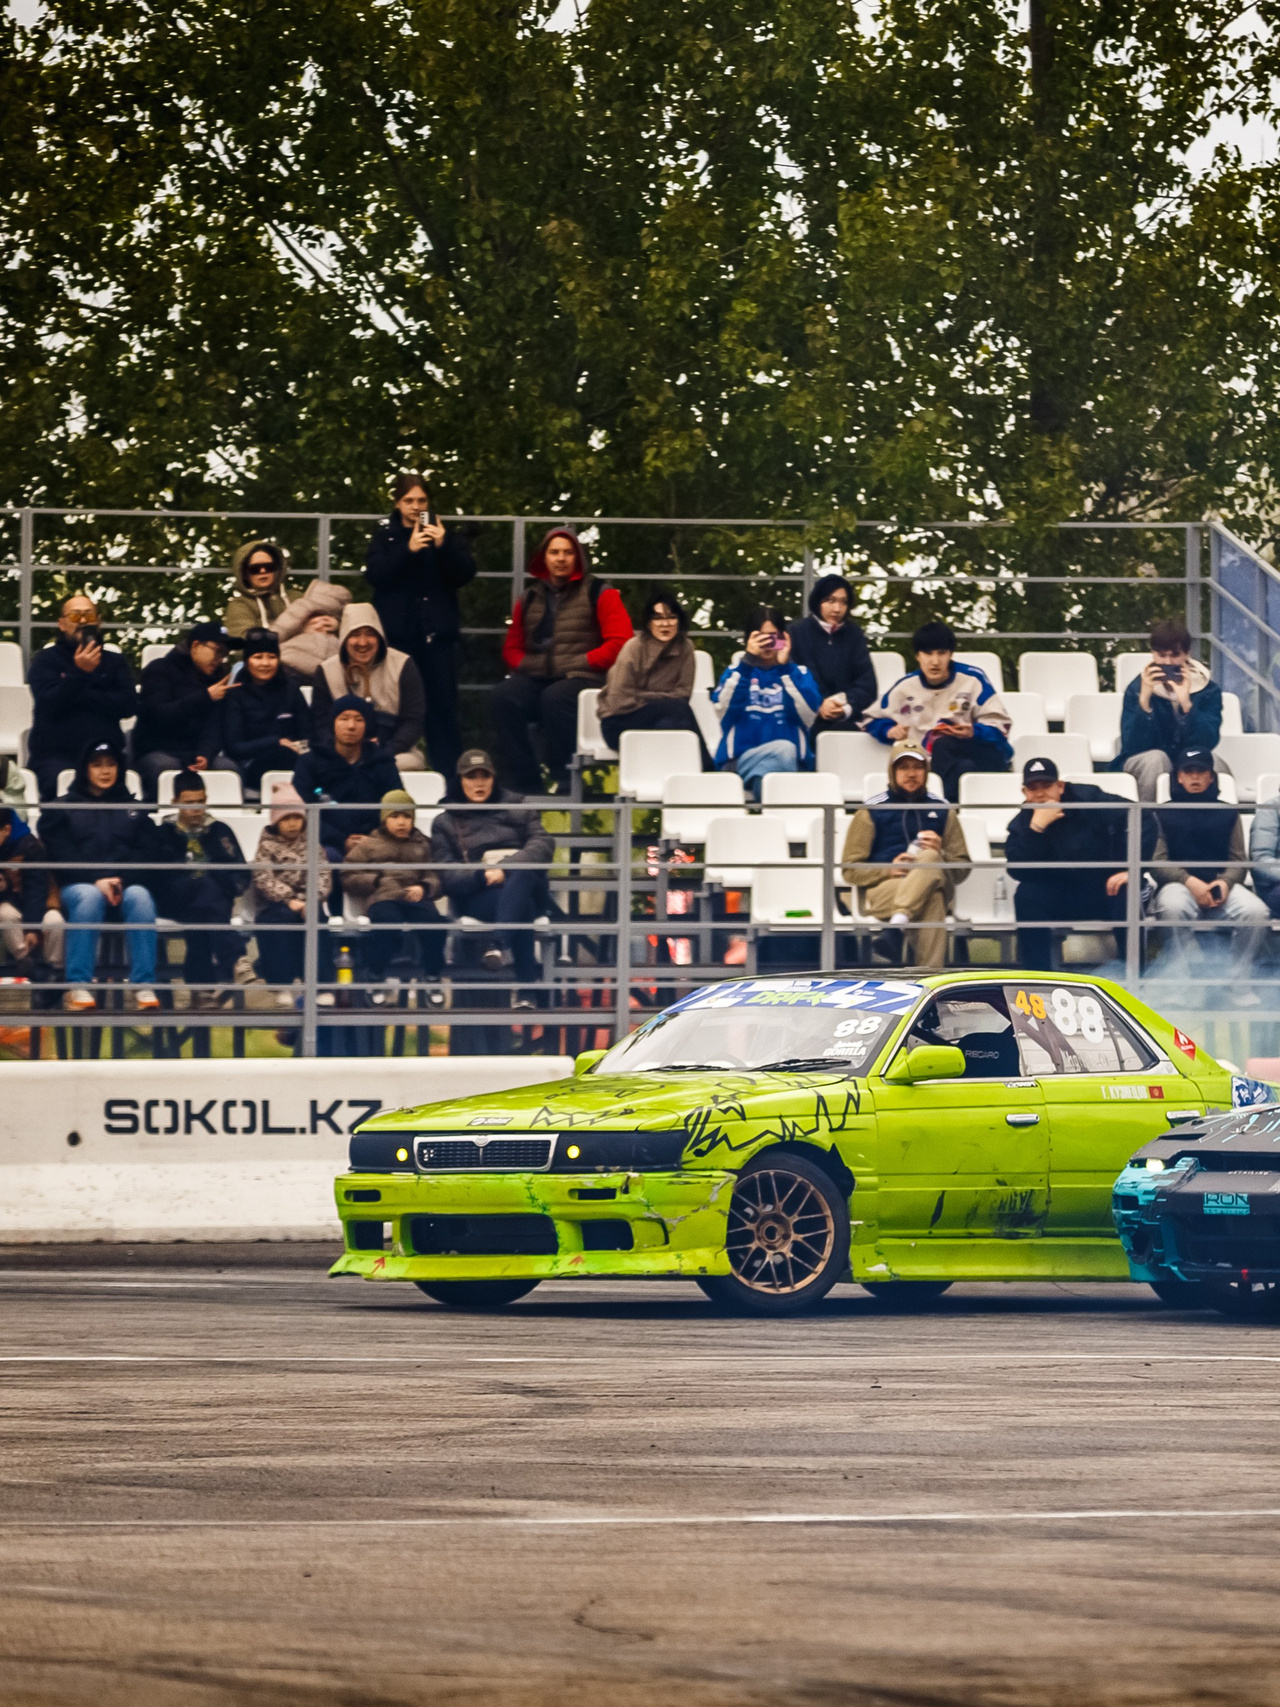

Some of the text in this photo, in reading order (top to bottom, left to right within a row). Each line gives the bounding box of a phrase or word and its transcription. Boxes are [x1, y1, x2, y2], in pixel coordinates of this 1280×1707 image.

[1016, 990, 1047, 1020] 48
[1051, 988, 1104, 1044] 88
[833, 1016, 882, 1038] 88
[965, 1049, 1000, 1059] RECARO
[104, 1099, 383, 1134] SOKOL.KZ
